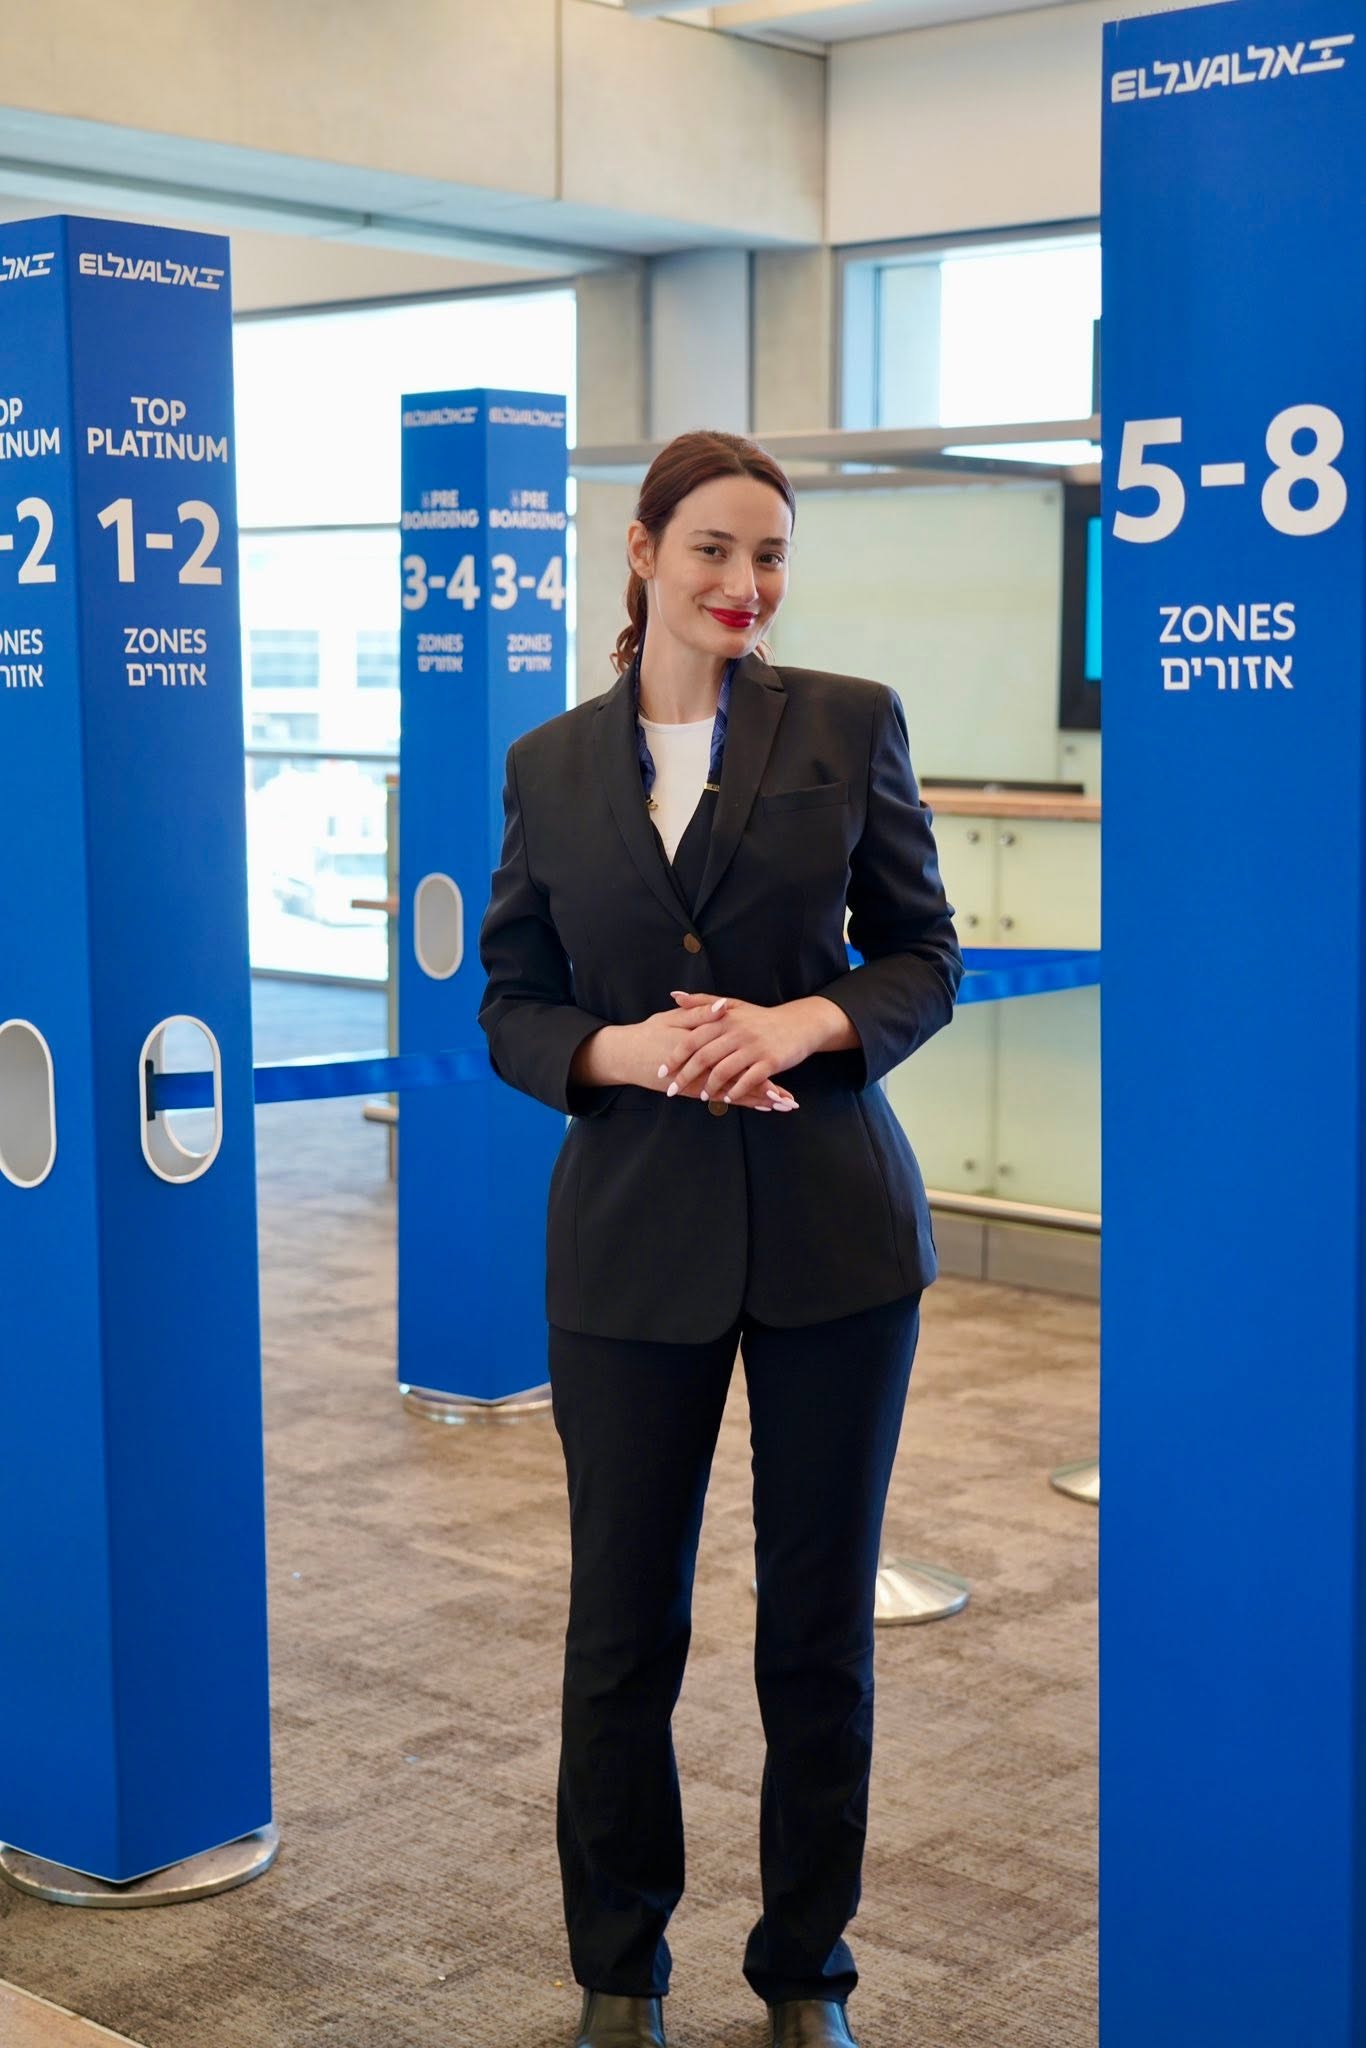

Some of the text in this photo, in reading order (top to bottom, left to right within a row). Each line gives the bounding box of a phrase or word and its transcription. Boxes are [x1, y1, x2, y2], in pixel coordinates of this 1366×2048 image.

[131, 396, 187, 428] TOP
[87, 427, 229, 464] PLATINUM
[1112, 403, 1348, 544] 5-8
[402, 509, 481, 530] BOARDING
[488, 509, 567, 531] BOARDING
[96, 497, 223, 586] 1-2
[402, 555, 481, 610] 3-4
[490, 554, 566, 611] 3-4
[1159, 603, 1296, 643] ZONES
[123, 627, 208, 655] ZONES
[417, 633, 464, 653] ZONES
[507, 633, 553, 653] ZONES
[126, 663, 208, 687] אזורים
[1161, 655, 1294, 691] אזורים
